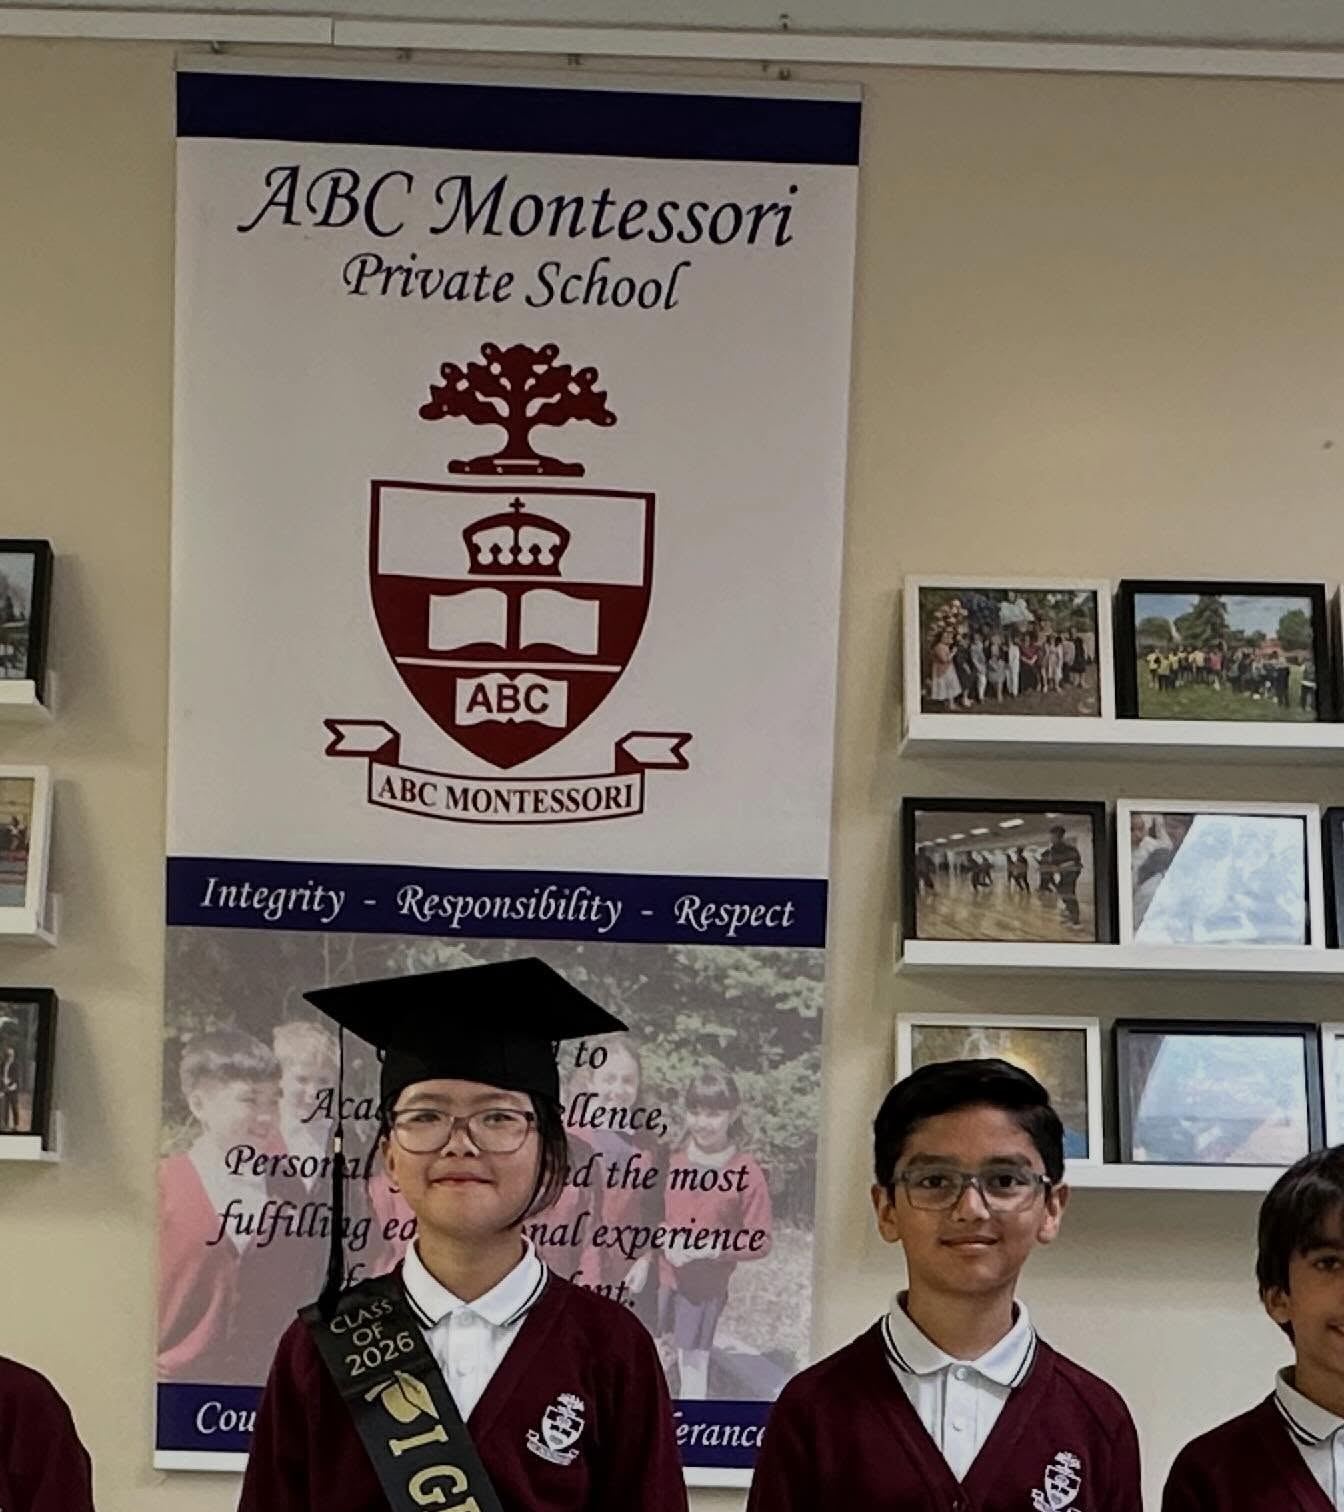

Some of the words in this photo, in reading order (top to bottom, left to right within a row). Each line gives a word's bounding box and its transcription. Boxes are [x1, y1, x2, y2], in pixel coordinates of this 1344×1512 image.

[236, 164, 414, 238] ABC
[429, 174, 798, 246] Montessori
[343, 252, 514, 302] Private
[524, 257, 691, 310] School
[464, 682, 550, 715] ABC
[377, 775, 439, 808] ABC
[445, 783, 634, 815] MONTESSORI
[200, 876, 345, 922] Integrity
[396, 884, 623, 926] Responsibility
[673, 894, 795, 935] Respect
[574, 1041, 608, 1069] to
[560, 1091, 669, 1137] llence,
[606, 1153, 658, 1190] the
[669, 1164, 750, 1193] most
[592, 1217, 766, 1260] experience
[330, 1299, 393, 1334] CLASS
[352, 1321, 384, 1347] OF
[344, 1331, 414, 1377] 2026
[388, 1424, 450, 1458] I
